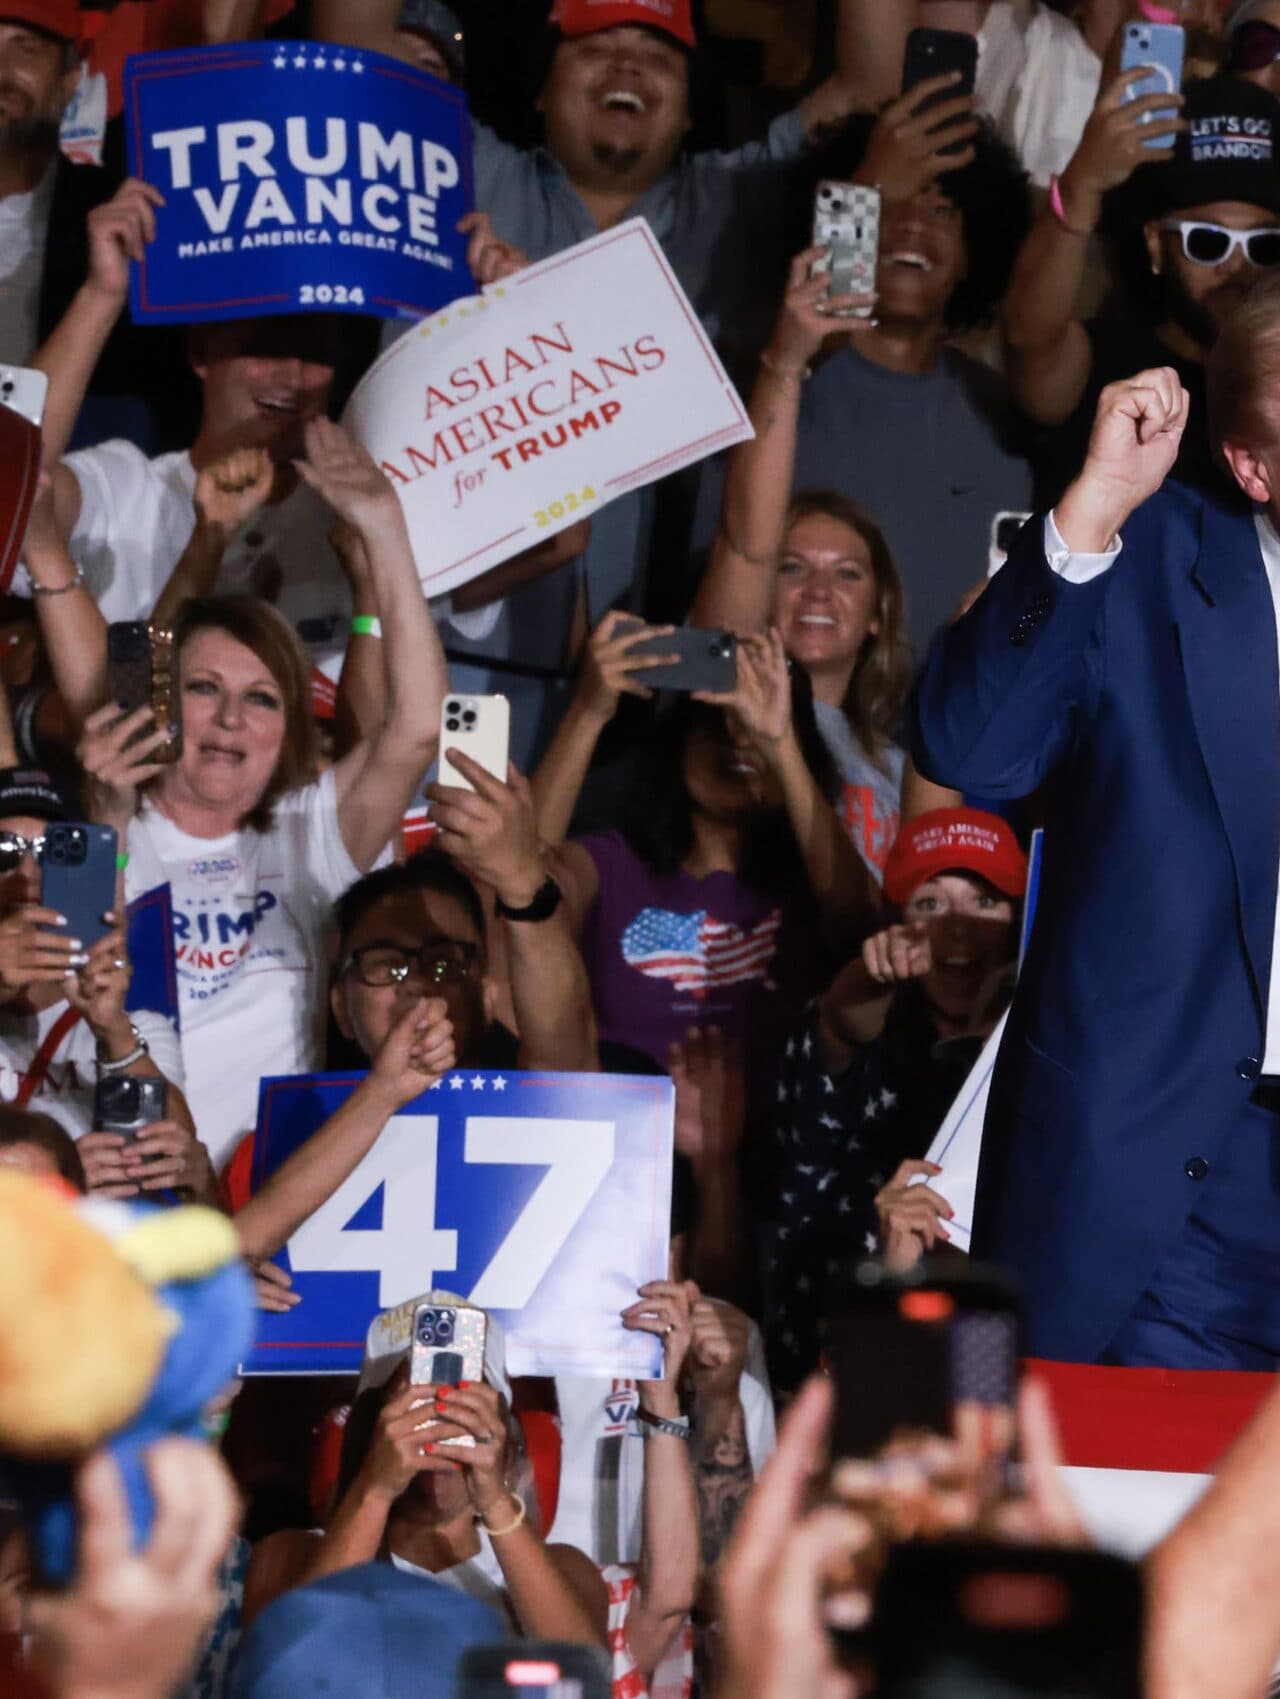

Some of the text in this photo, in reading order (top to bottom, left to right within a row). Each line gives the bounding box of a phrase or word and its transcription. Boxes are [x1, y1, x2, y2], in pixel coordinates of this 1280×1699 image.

[152, 116, 459, 198] TRUMP
[1190, 115, 1271, 136] LET'S GO
[178, 236, 234, 259] MAKE
[240, 229, 332, 249] AMERICA
[338, 230, 396, 252] GREAT
[193, 177, 439, 246] VANCE
[299, 284, 366, 305] 2024
[423, 322, 574, 422] ASIAN
[378, 336, 666, 485] AMERICANS
[453, 400, 622, 509] for TRUMP
[533, 485, 597, 529] 2024
[288, 1114, 616, 1310] 47
